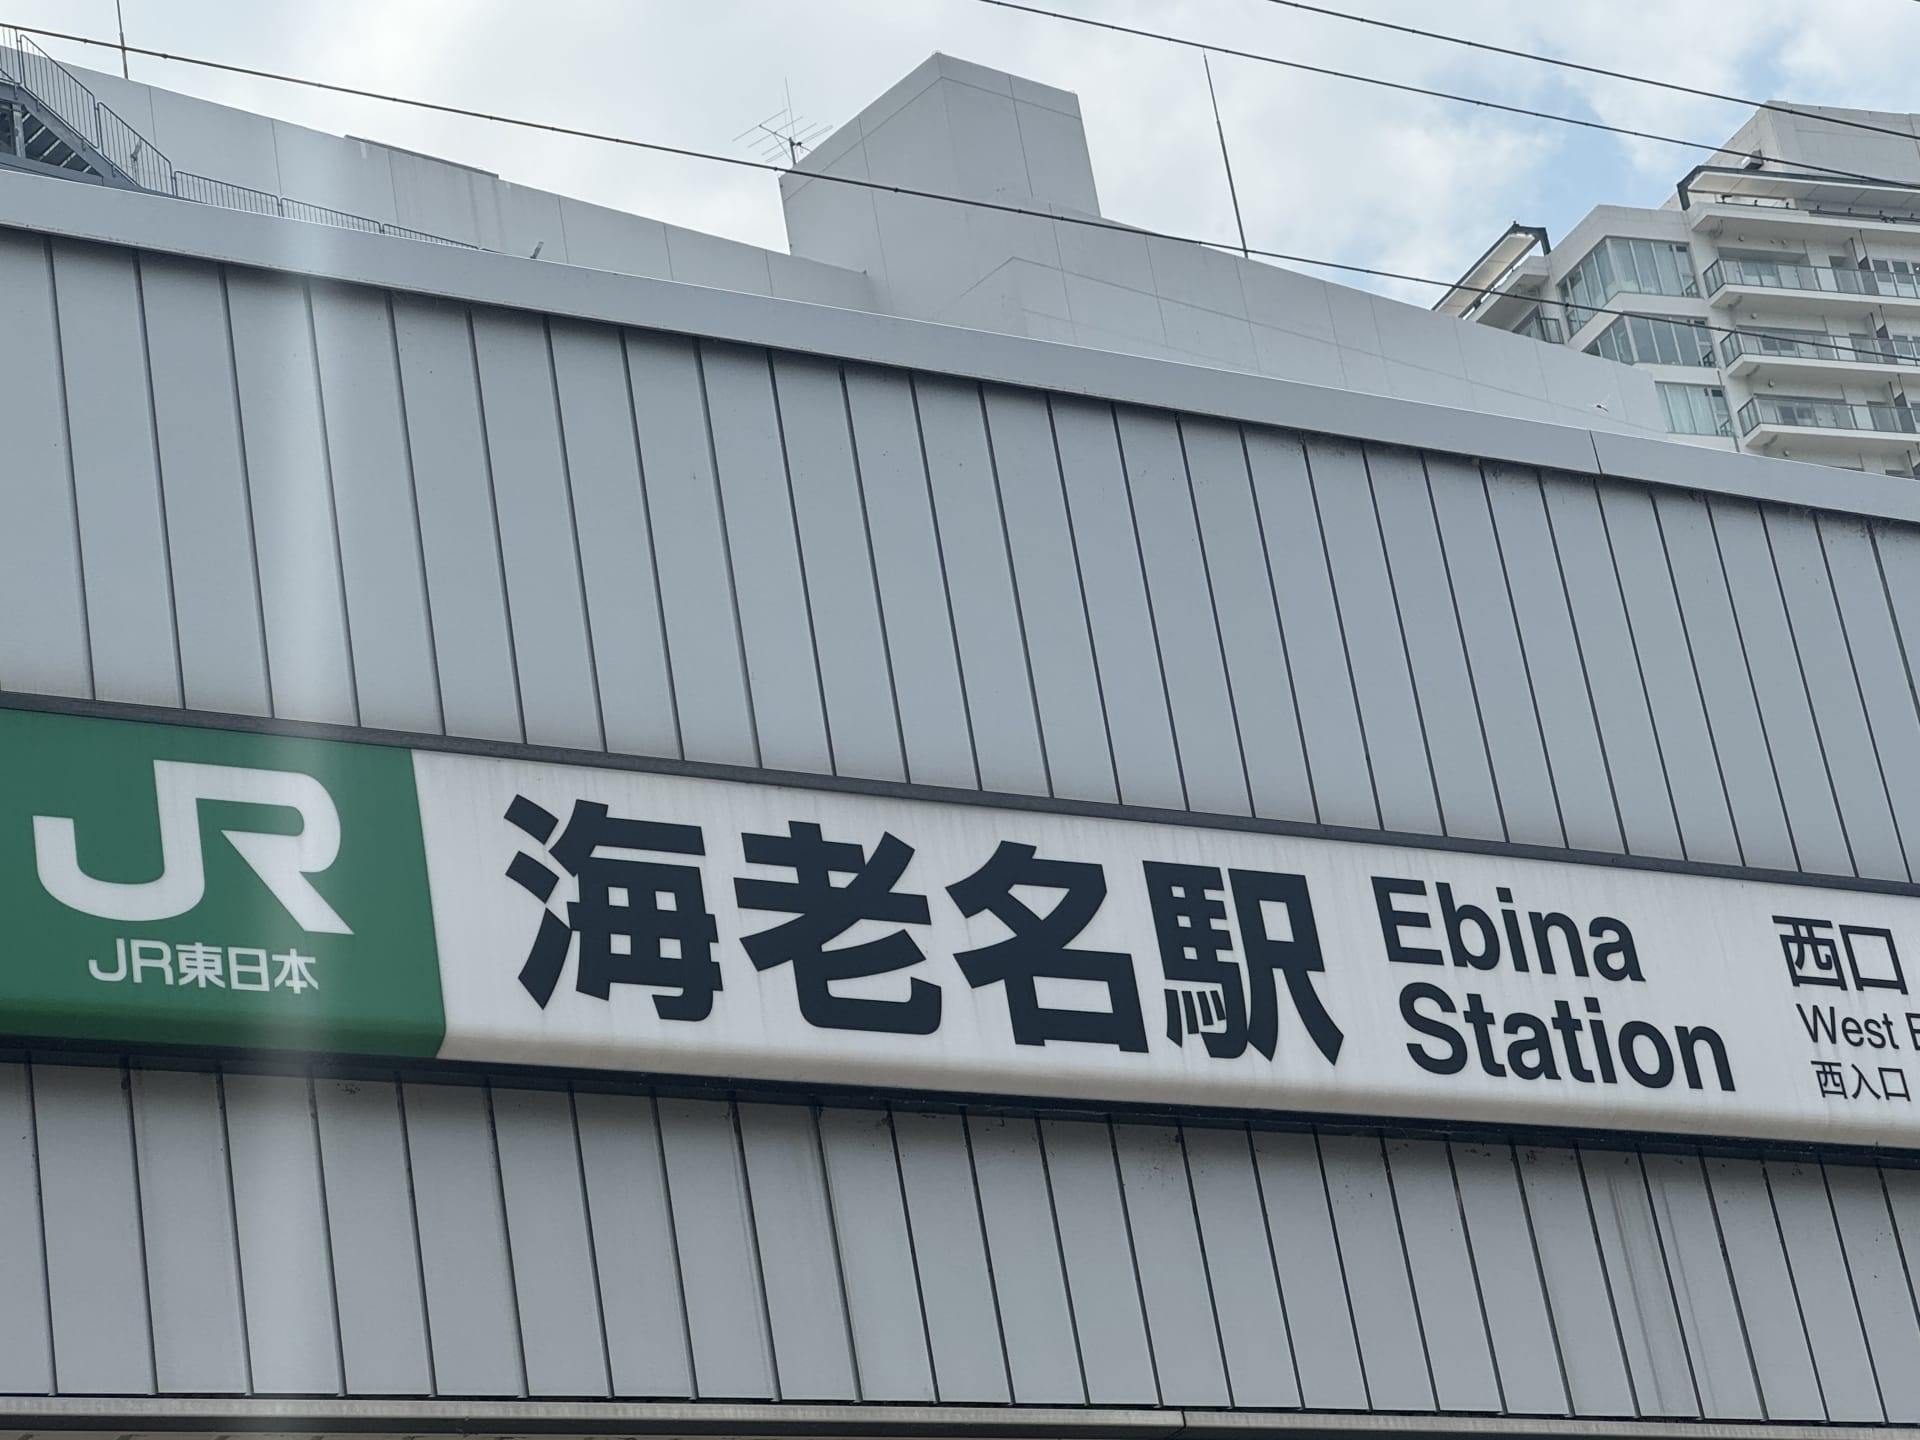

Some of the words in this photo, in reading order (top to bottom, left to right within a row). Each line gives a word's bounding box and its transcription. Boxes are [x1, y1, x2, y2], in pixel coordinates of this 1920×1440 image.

[33, 760, 354, 935] JR
[89, 938, 319, 993] JR東日本
[504, 794, 1344, 1065] 海老名駅
[1371, 876, 1646, 982] Ebina
[1772, 915, 1908, 995] 西口
[1399, 982, 1736, 1092] Station
[1796, 1003, 1900, 1050] West
[1811, 1060, 1911, 1102] 西入口
